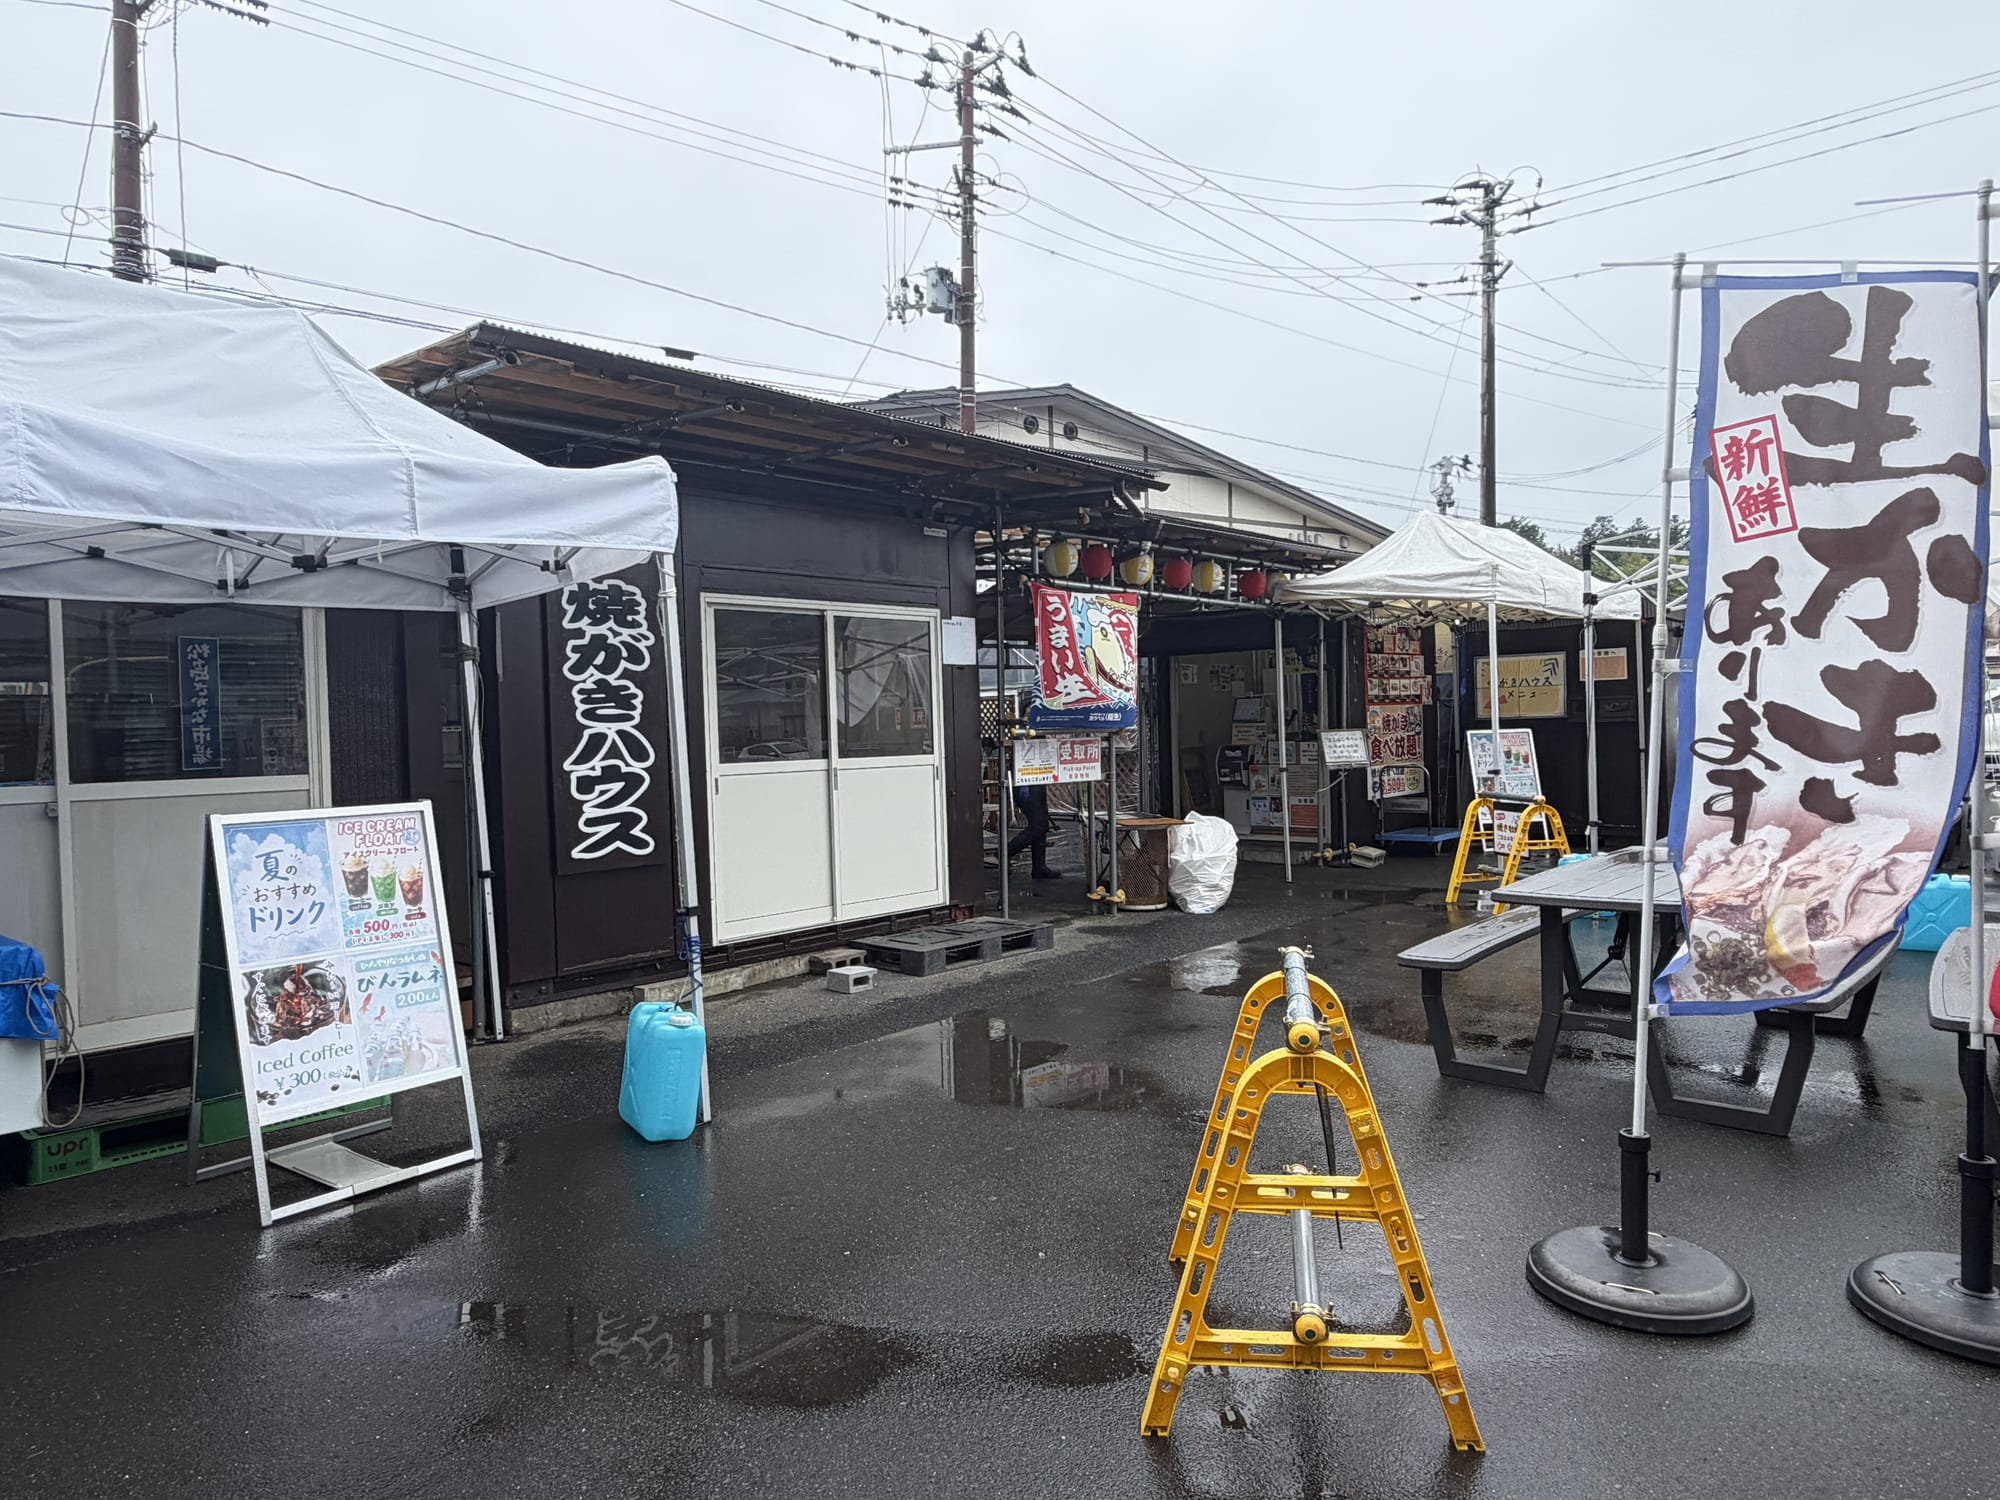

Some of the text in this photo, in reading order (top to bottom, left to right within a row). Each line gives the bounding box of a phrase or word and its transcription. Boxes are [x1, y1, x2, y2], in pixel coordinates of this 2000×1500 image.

[1720, 429, 1787, 533] 新鮮
[1703, 284, 1987, 824] 生かき
[1046, 594, 1098, 704] うまい生
[1507, 690, 1549, 699] メニュー
[1690, 555, 1790, 846] あります
[561, 578, 656, 860] 焼がきハウス
[1060, 742, 1099, 761] 受取所
[1477, 760, 1493, 768] ドリン
[337, 817, 416, 835] ICE CREAM
[355, 831, 403, 848] FLOAT
[255, 850, 298, 881] 夏の
[343, 847, 419, 859] アイスクリームフロート
[254, 882, 317, 903] おすすめ
[249, 900, 325, 933] ドリンク
[357, 965, 443, 992] びんラムネ
[257, 1043, 354, 1075] Iced Coffee
[47, 1137, 89, 1156] upr
